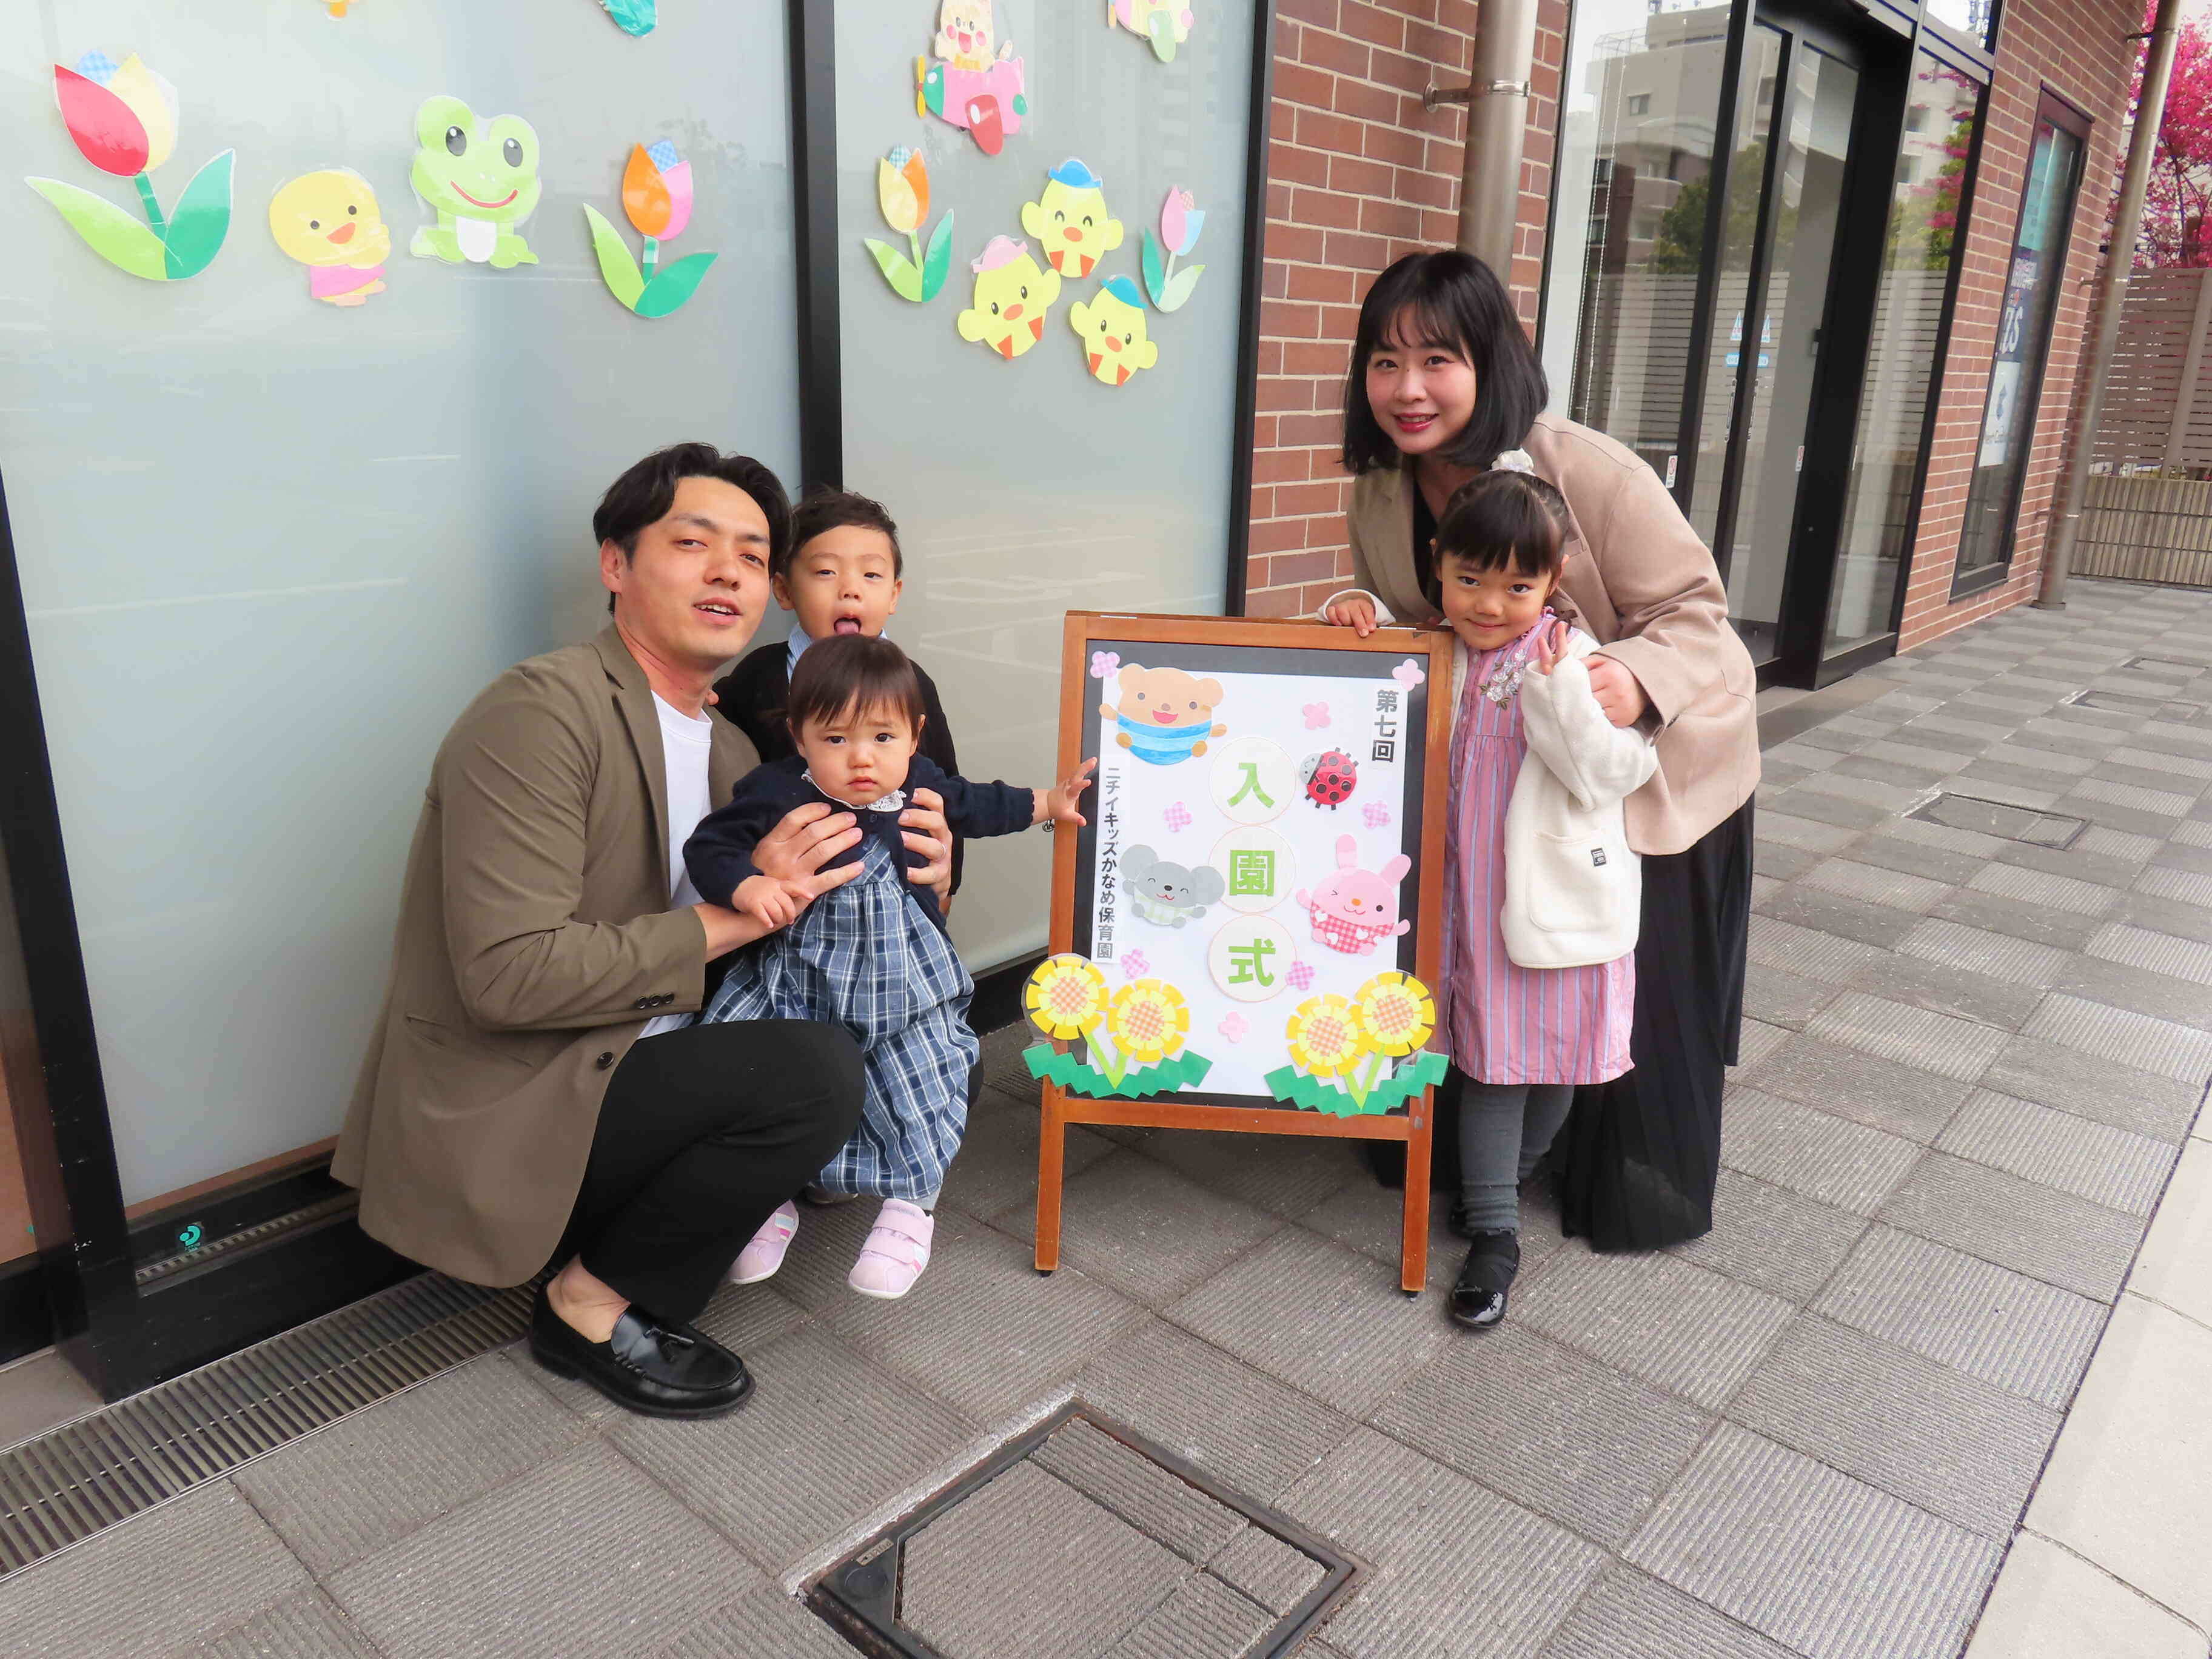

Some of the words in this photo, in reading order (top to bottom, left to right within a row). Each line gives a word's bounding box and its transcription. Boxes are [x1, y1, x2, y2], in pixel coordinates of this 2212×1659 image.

[1372, 689, 1399, 762] 第七回
[1097, 768, 1121, 959] ニチイキッズかなめ保育園
[1227, 763, 1276, 987] 入園式
